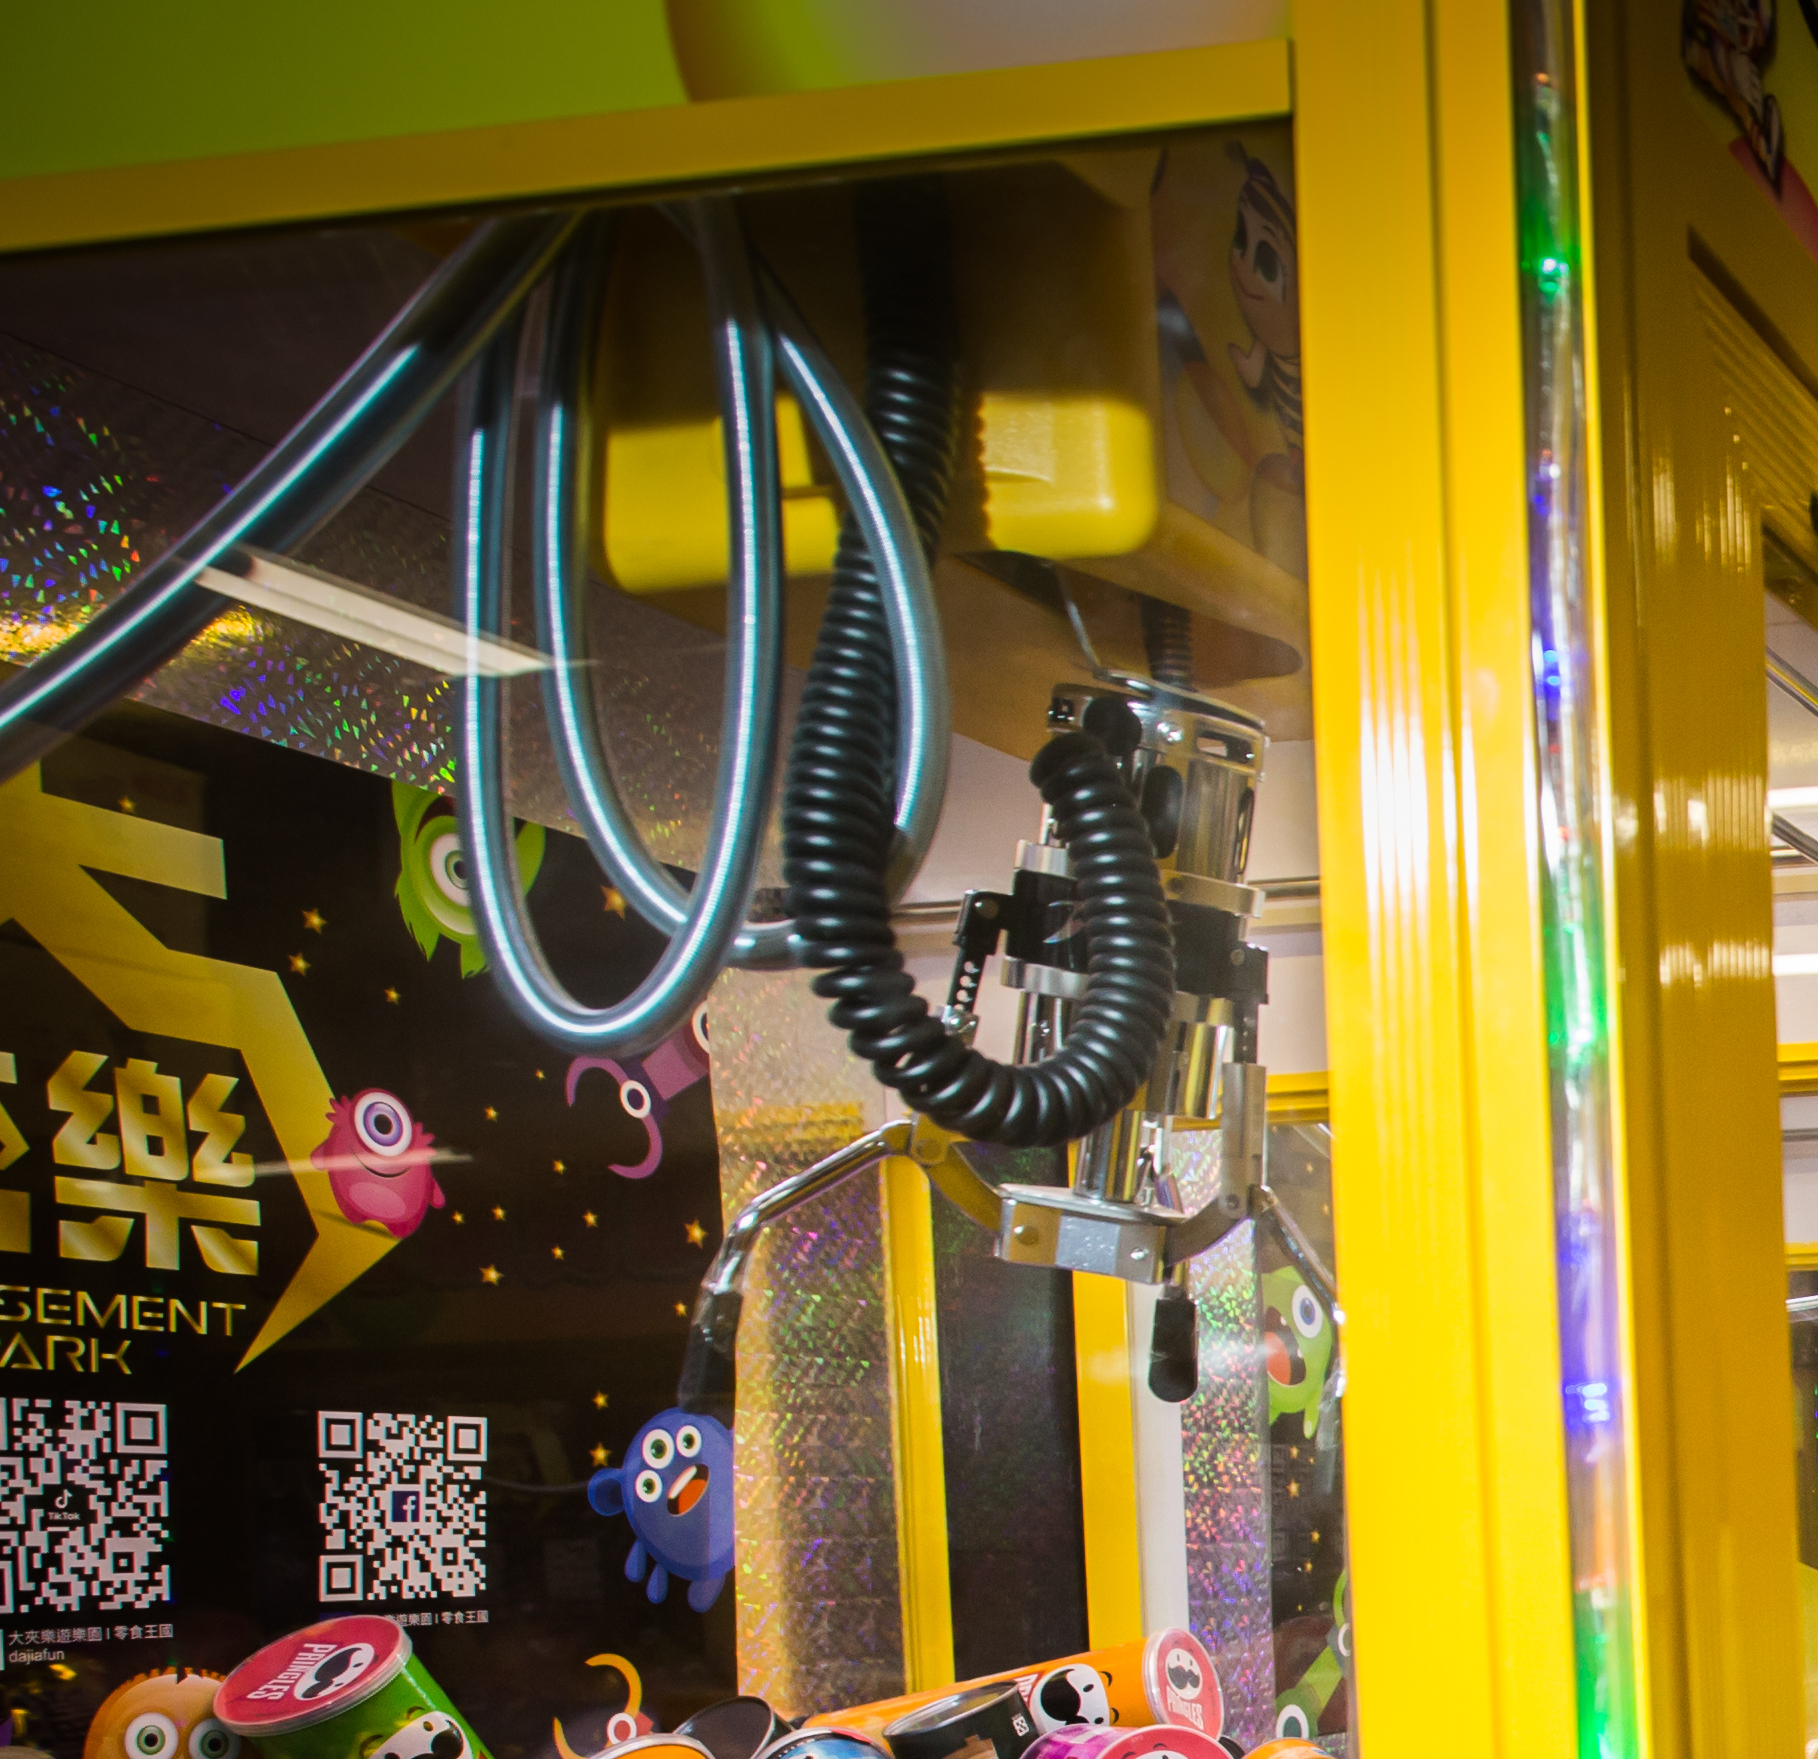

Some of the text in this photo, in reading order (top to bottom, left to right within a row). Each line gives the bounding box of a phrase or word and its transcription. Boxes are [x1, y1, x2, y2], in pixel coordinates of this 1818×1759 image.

[0, 1050, 261, 1276] 樂
[8, 1648, 65, 1664] dajiafun
[246, 1643, 338, 1702] PRINGLES
